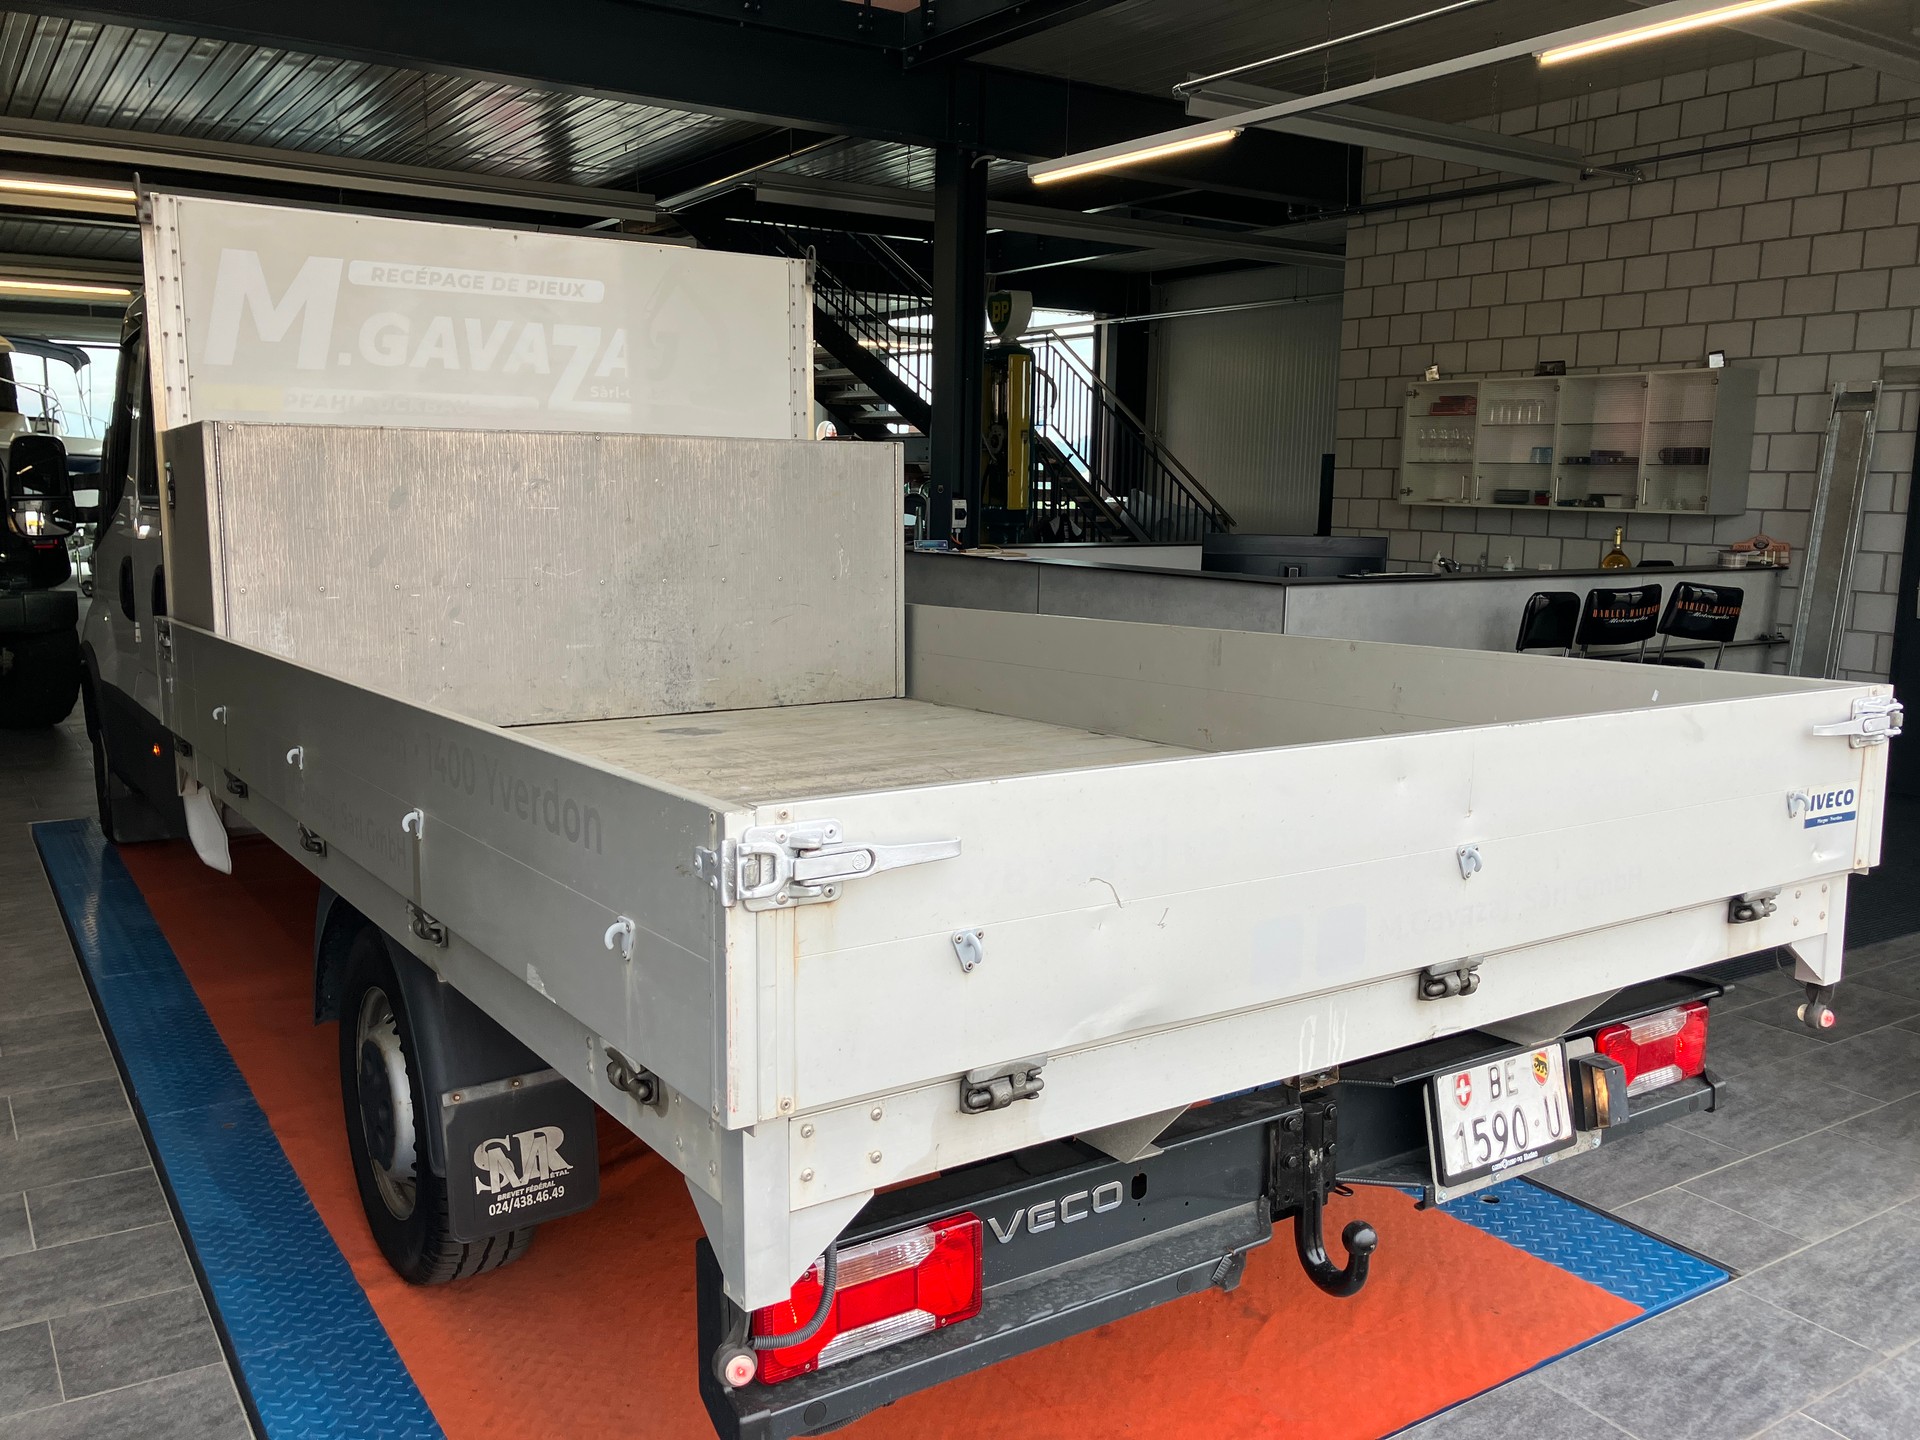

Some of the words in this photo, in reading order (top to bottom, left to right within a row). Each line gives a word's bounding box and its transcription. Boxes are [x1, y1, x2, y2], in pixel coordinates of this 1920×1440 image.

[371, 265, 485, 291] RECÉPAGE
[491, 276, 519, 293] DE
[526, 279, 585, 298] PIEUX
[992, 301, 1009, 323] BP
[483, 754, 603, 855] Yverdon
[1809, 788, 1854, 812] IVECO
[1488, 1059, 1518, 1101] BE
[488, 1185, 565, 1216] 024/438.46.49
[497, 1188, 525, 1202] BREVET
